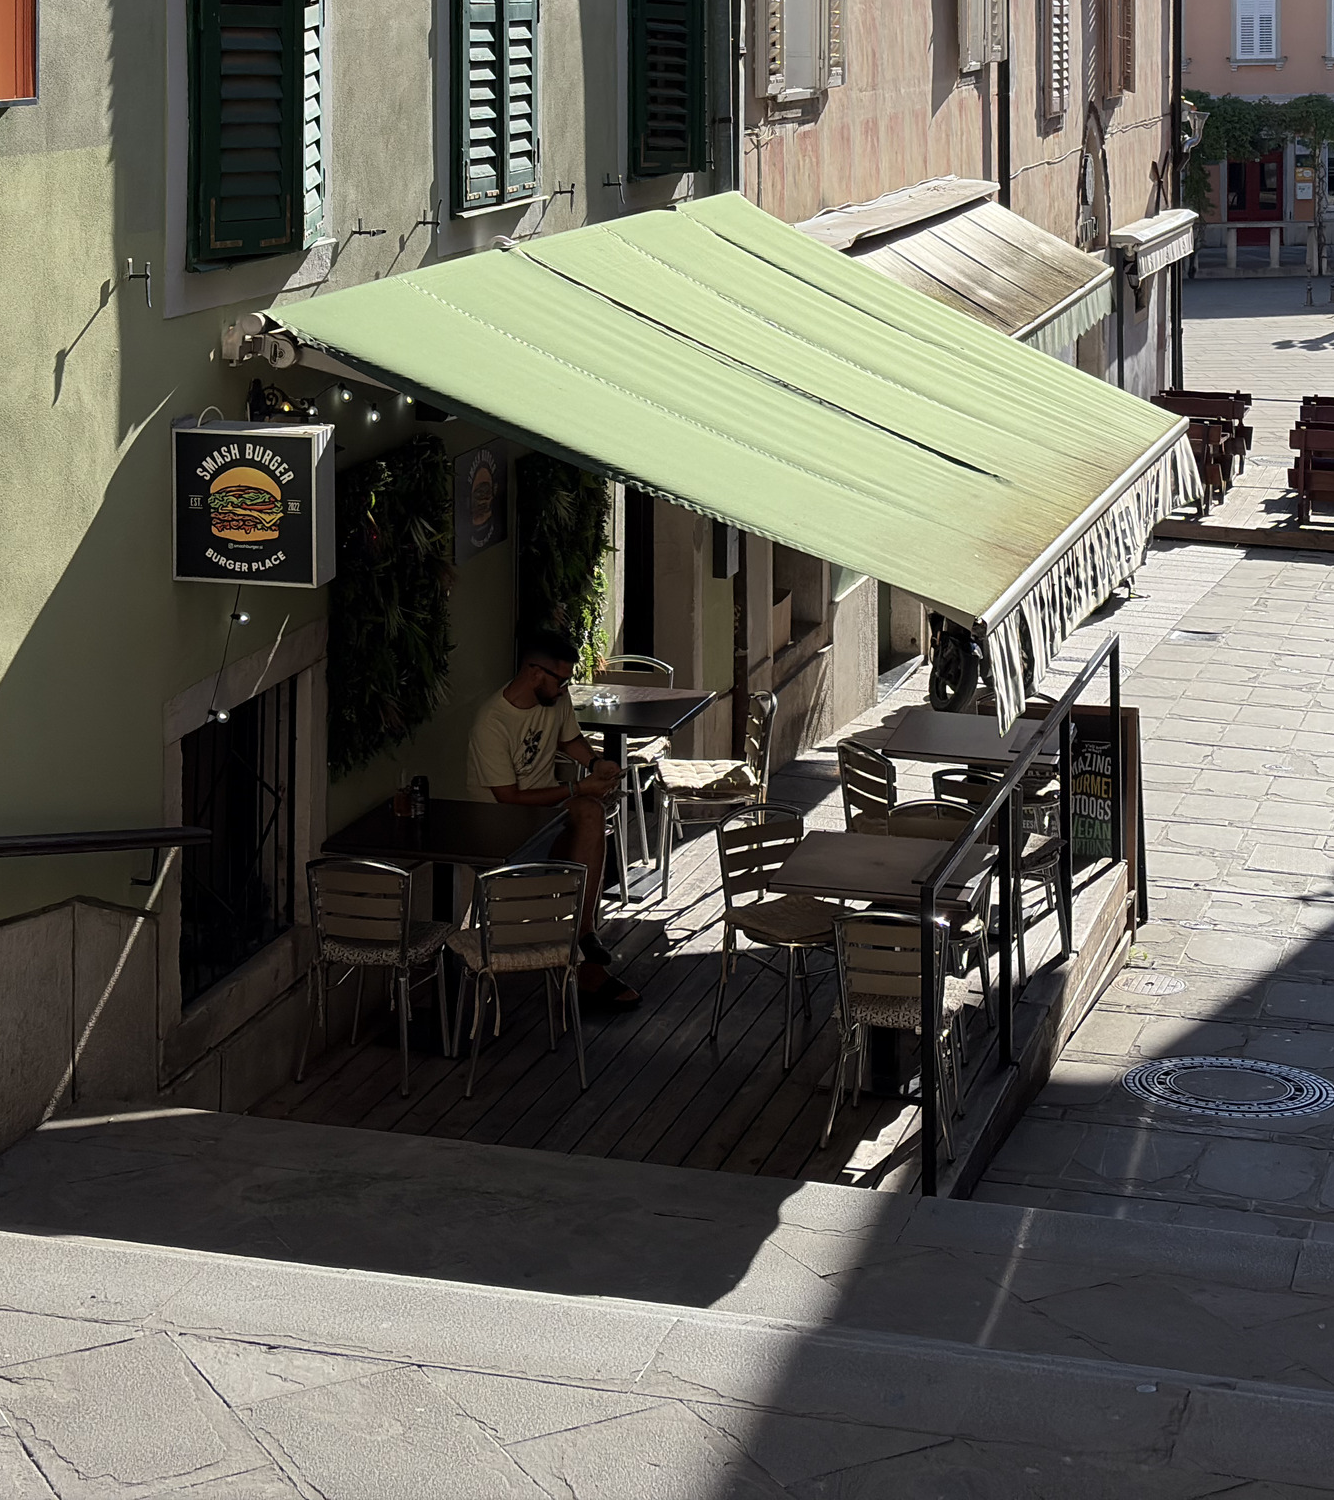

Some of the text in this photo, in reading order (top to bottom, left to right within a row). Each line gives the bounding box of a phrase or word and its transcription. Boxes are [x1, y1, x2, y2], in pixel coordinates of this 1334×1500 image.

[196, 443, 295, 484] SMASH BURGER
[190, 497, 203, 507] EST.
[288, 501, 301, 511] 2022
[205, 548, 287, 572] BURGER PLACE
[1070, 753, 1112, 776] MAZING
[1070, 774, 1112, 799] OURMET
[1070, 794, 1112, 821] OTDOGS
